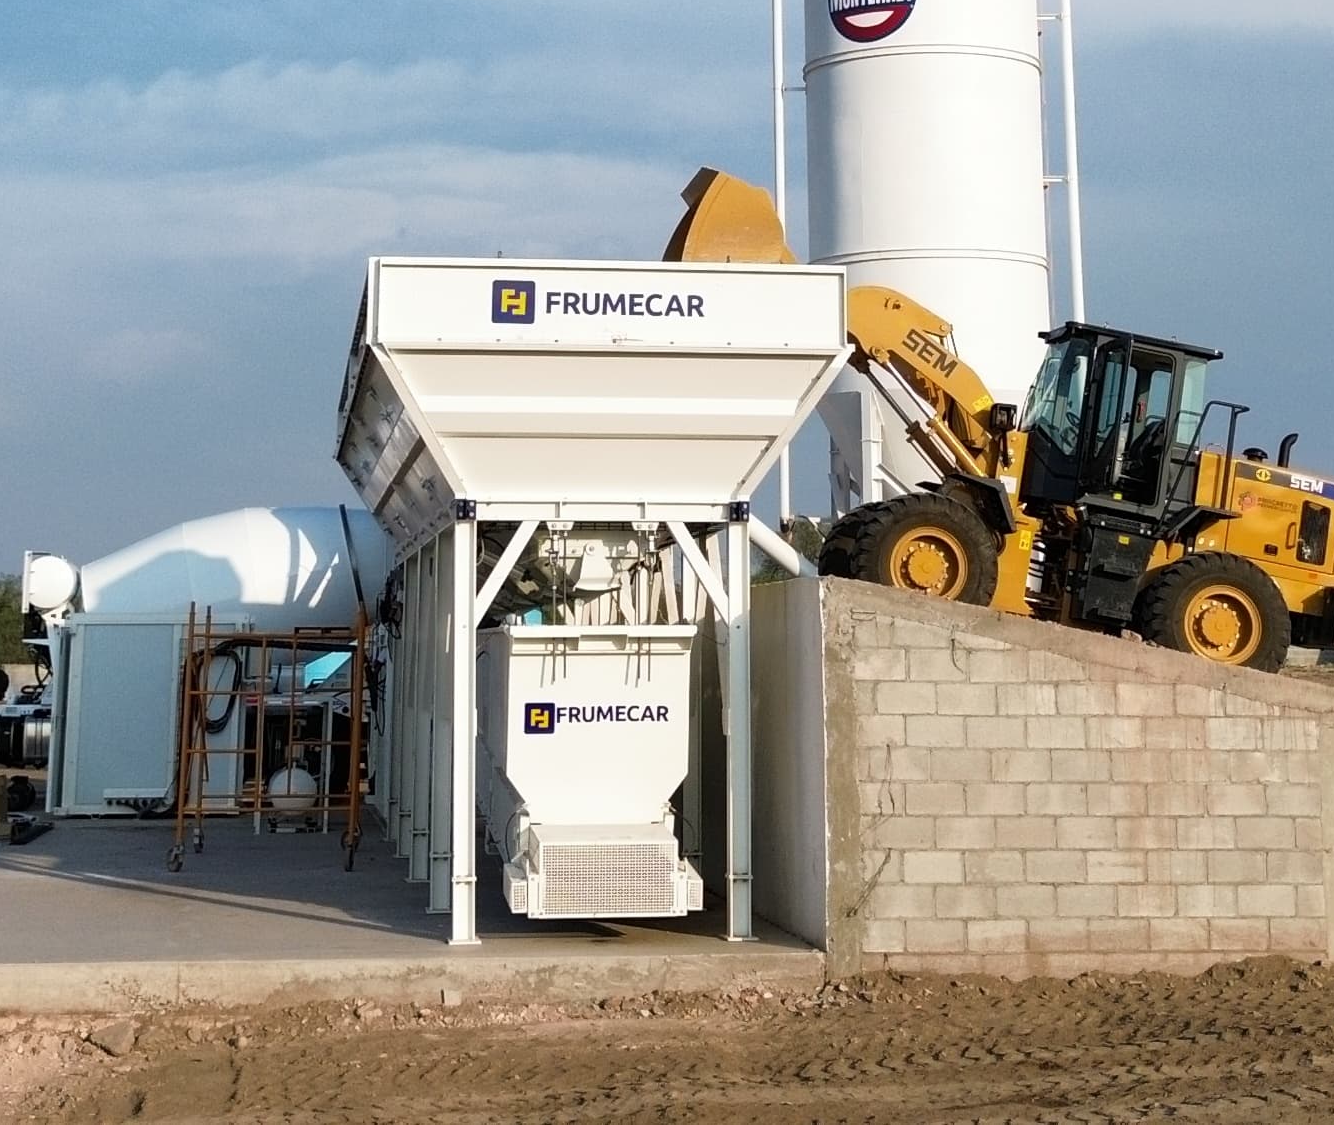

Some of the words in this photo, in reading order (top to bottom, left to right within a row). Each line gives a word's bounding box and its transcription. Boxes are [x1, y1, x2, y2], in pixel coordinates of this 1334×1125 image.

[546, 292, 705, 317] FRUMECAR
[902, 328, 958, 378] SEM
[1289, 475, 1324, 494] SEM
[556, 705, 669, 723] FRUMECAR
